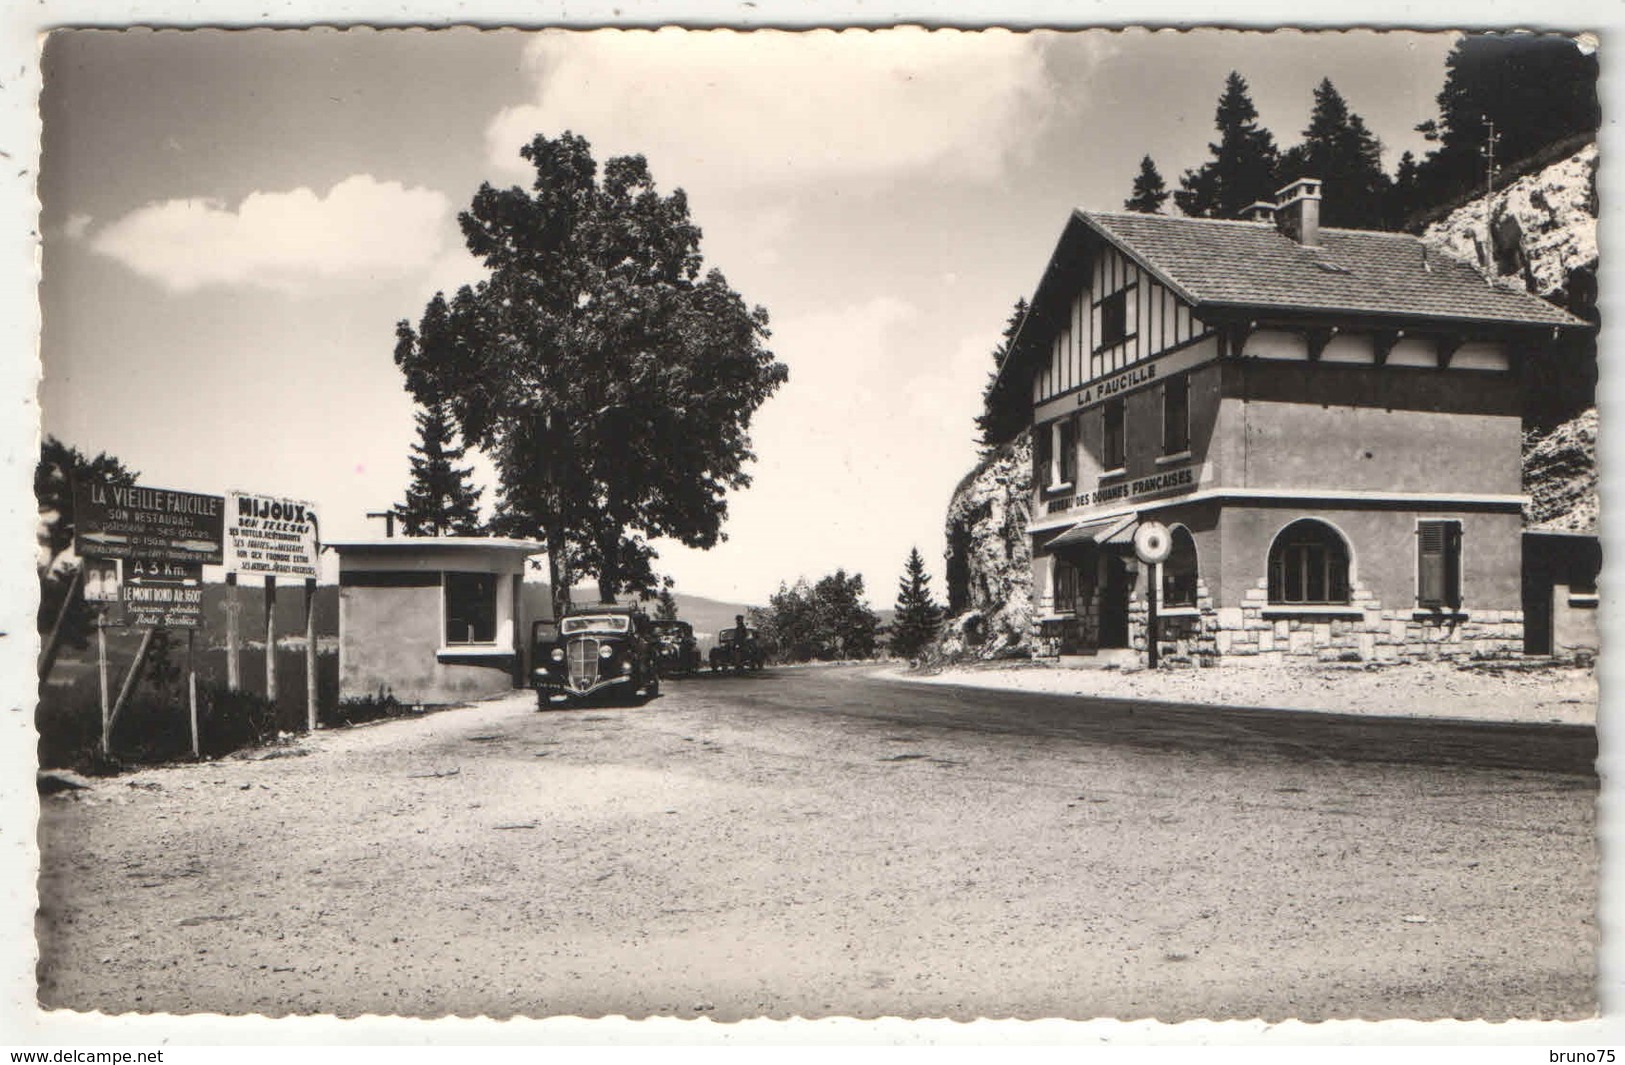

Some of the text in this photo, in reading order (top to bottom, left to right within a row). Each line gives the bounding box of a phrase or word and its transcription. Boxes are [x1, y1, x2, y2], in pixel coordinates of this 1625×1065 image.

[1077, 364, 1156, 405] LA FAUCILLE
[92, 484, 106, 504] LA
[114, 486, 163, 510] VIEILLE
[167, 493, 217, 516] FAUCILLE
[1076, 495, 1089, 507] DES
[1093, 484, 1129, 503] DOUANES
[109, 509, 128, 521] SON
[238, 497, 305, 523] MIJOUX
[238, 518, 310, 534] SON TELESKI
[134, 561, 144, 574] A
[149, 562, 159, 575] 3
[123, 587, 132, 601] LE
[133, 587, 152, 601] MONT
